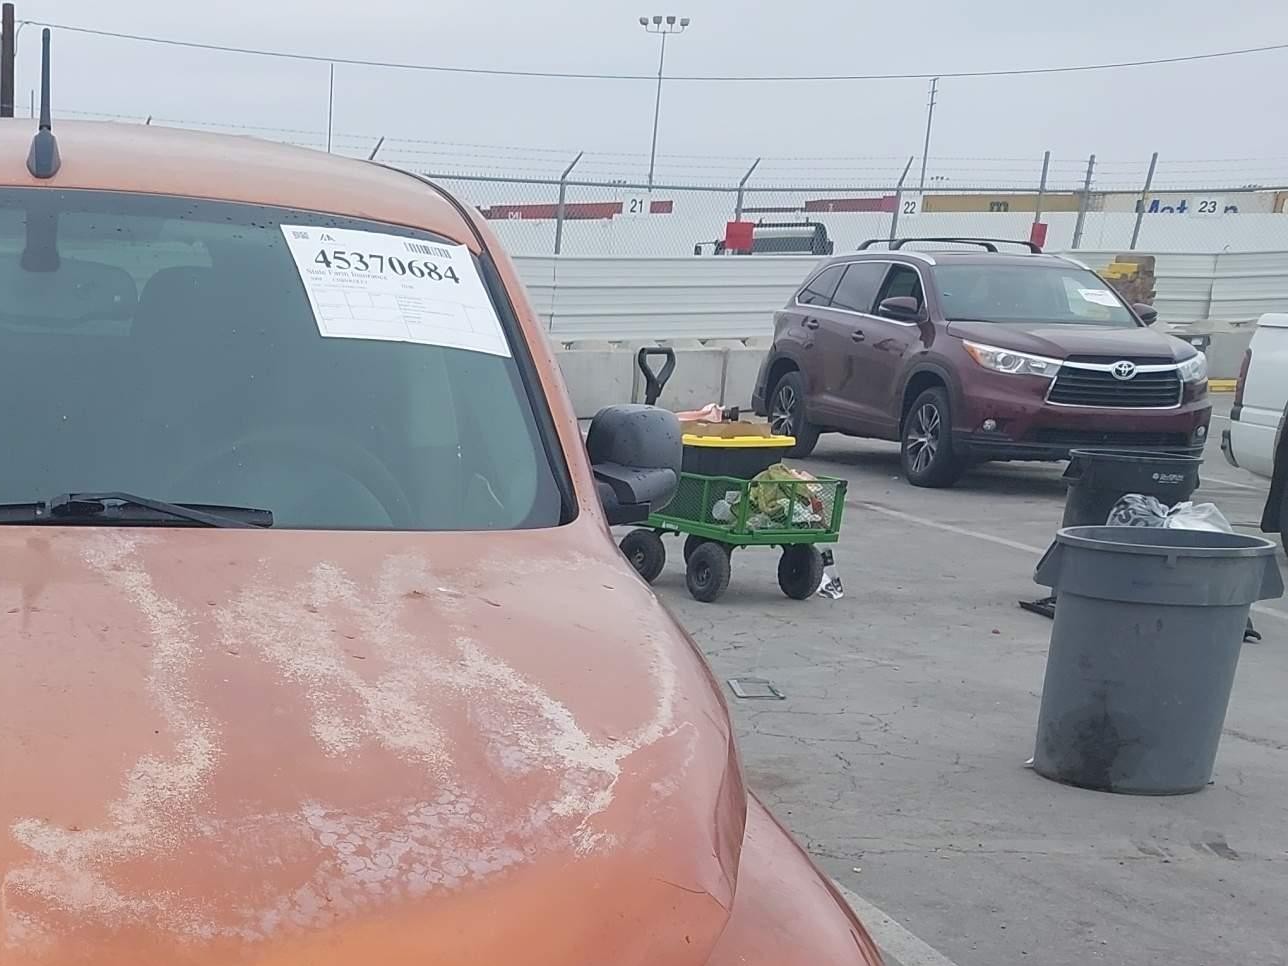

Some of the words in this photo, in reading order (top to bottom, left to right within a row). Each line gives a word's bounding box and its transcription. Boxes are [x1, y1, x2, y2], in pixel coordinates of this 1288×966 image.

[629, 199, 644, 213] 21
[903, 201, 917, 215] 22
[1198, 200, 1218, 213] 23
[314, 248, 461, 285] 45370684
